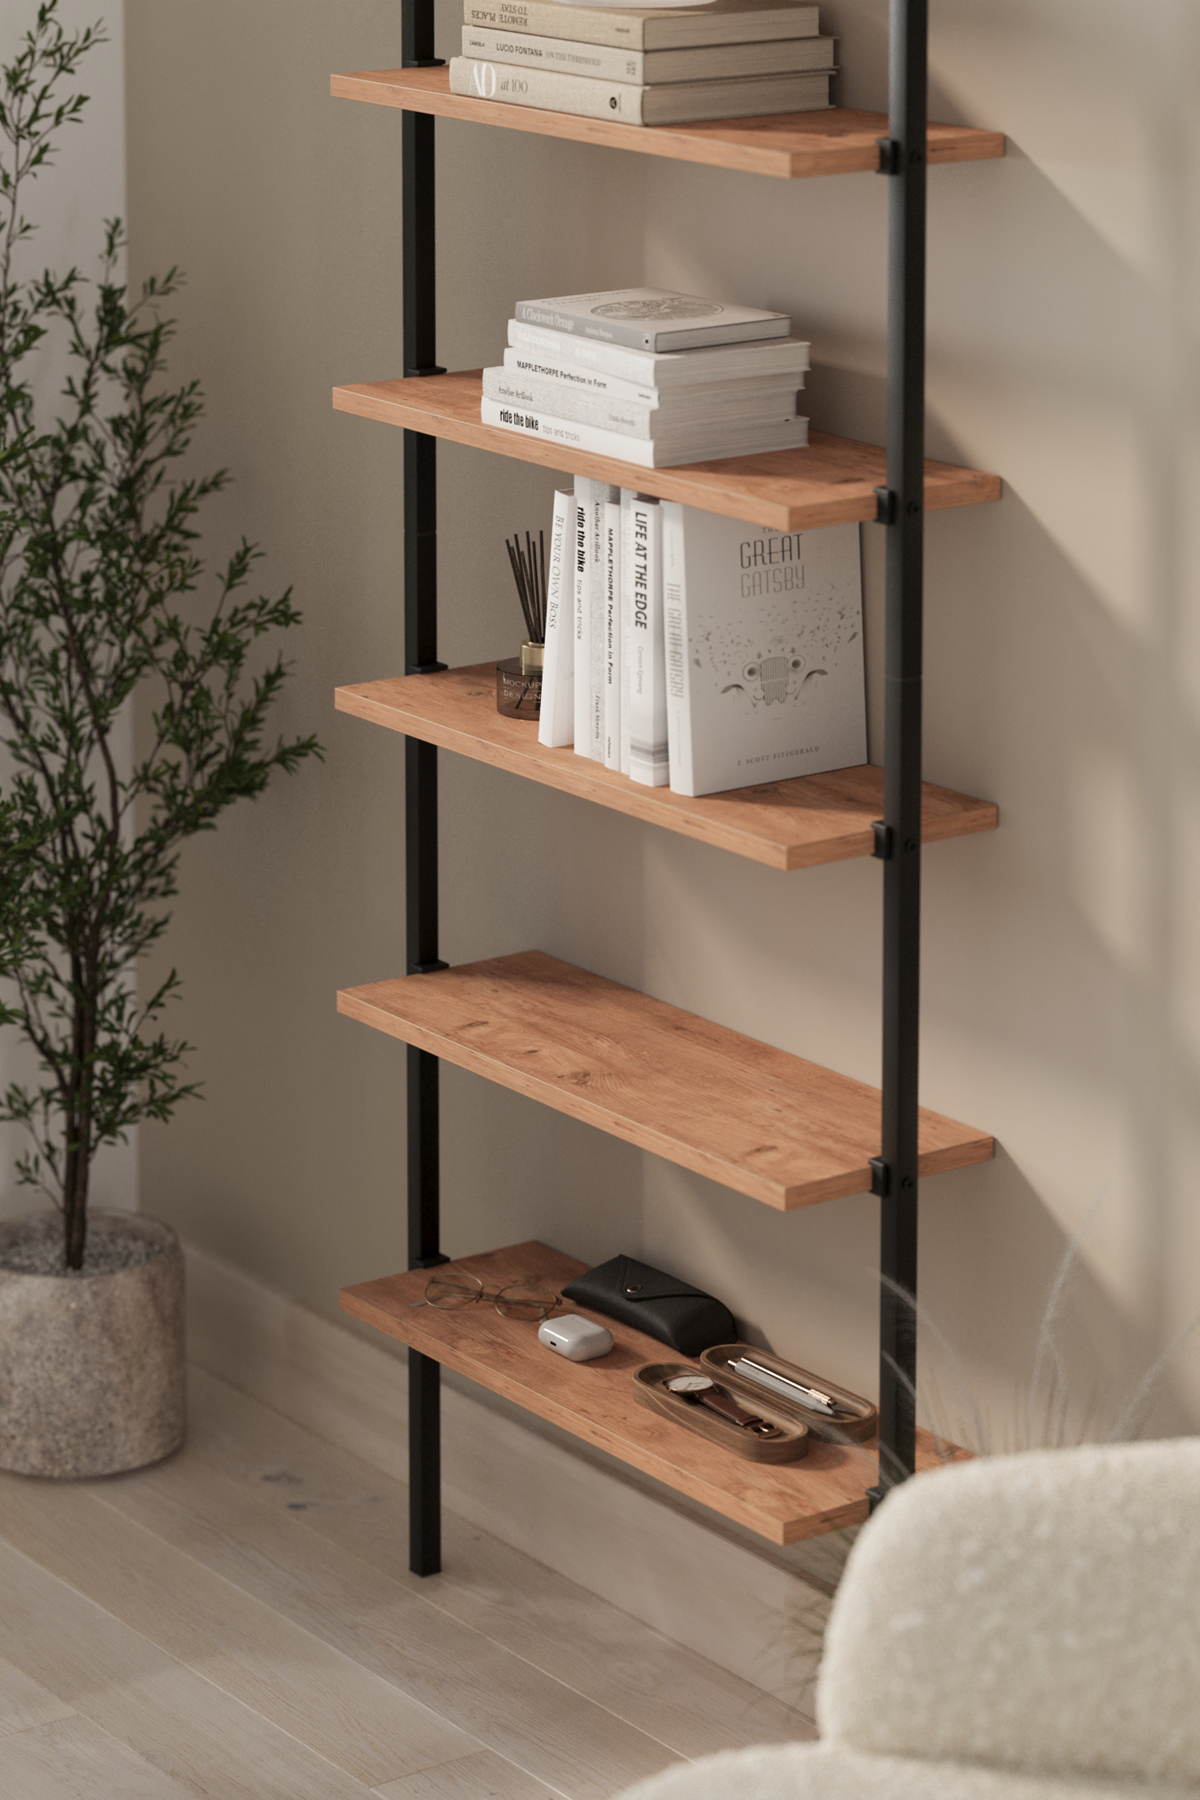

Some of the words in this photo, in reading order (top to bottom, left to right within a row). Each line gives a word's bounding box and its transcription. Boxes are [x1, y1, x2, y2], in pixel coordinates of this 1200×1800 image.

[471, 10, 496, 22] PLACES
[499, 14, 528, 26] REMOTE
[500, 4, 517, 14] STAY
[518, 6, 528, 15] TO
[496, 43, 514, 53] LUCIO
[515, 46, 543, 57] FONTANA
[501, 79, 510, 91] at
[511, 79, 528, 94] 100
[521, 306, 526, 320] A
[526, 308, 554, 327] Clockwork
[554, 315, 574, 332] Orange
[517, 360, 559, 378] MAPPLETHORPE
[560, 370, 586, 385] Perfection
[587, 377, 592, 385] in
[594, 379, 607, 389] Form
[500, 409, 512, 424] ride
[514, 412, 524, 426] the
[525, 416, 539, 431] bike
[543, 424, 552, 435] tips
[554, 428, 564, 438] and
[565, 430, 580, 442] tricks
[555, 516, 564, 529] BE
[577, 506, 585, 528] ride
[635, 511, 647, 541] LIFE
[552, 533, 563, 563] YOUR
[577, 530, 586, 548] the
[577, 550, 585, 573] bike
[635, 542, 647, 561] AT
[740, 533, 804, 569] GREAT
[550, 566, 561, 599] OWN
[635, 563, 647, 588] THE
[740, 565, 805, 598] GATSBY
[667, 583, 681, 604] THE
[548, 602, 558, 629] BOSS
[635, 592, 647, 630] EDGE
[667, 608, 683, 648] GREAT
[608, 651, 613, 660] in
[503, 678, 541, 688] MOCKUP
[669, 651, 684, 698] GATSBY
[504, 690, 541, 700] DESIGN
[746, 755, 770, 765] SCOTT
[773, 745, 820, 760] FITZGERALD
